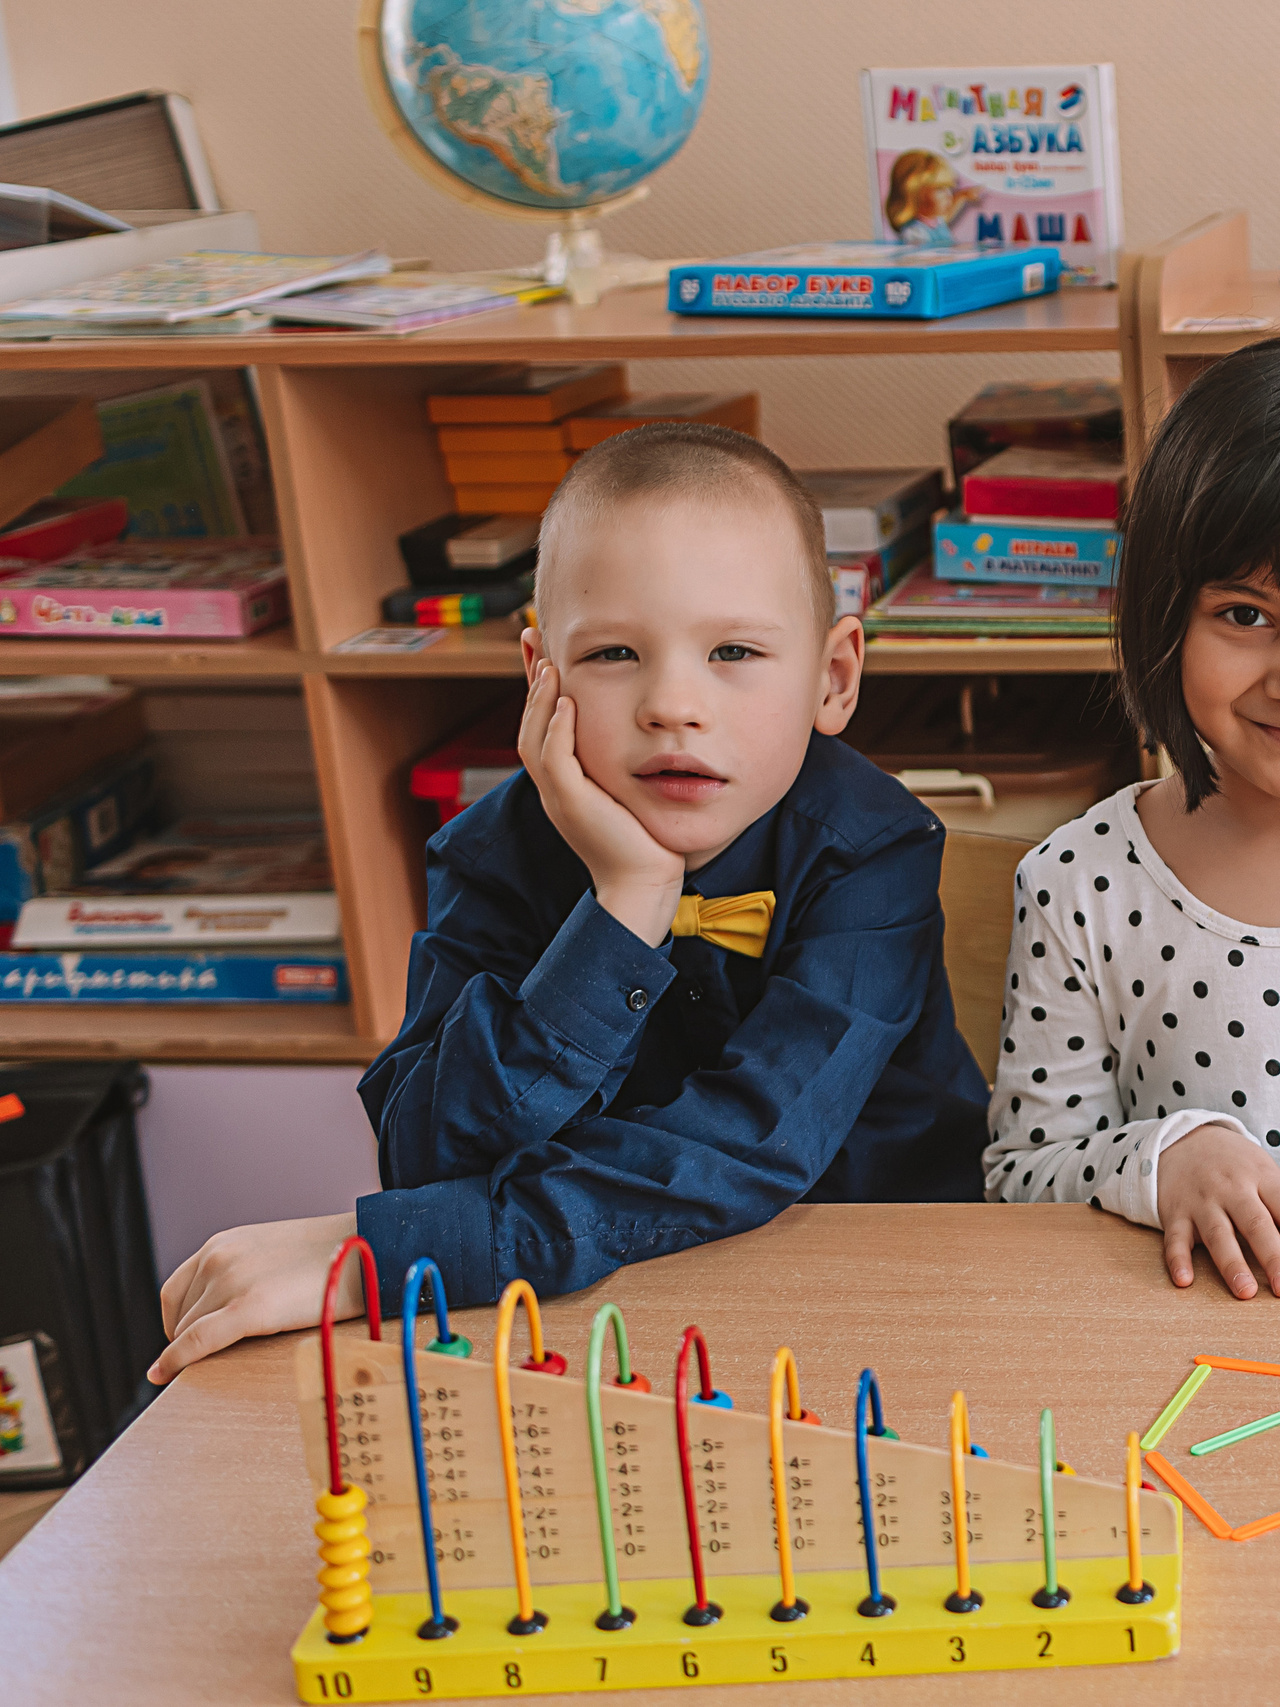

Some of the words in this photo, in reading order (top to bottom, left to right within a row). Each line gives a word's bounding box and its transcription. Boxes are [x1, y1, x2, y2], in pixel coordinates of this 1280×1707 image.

[972, 123, 1084, 153] АЗБУКА
[977, 213, 1092, 242] МАША
[712, 273, 799, 293] НАБОР
[806, 275, 875, 294] БУКВ
[316, 1671, 353, 1699] 10
[413, 1666, 433, 1694] 9
[503, 1661, 523, 1689] 8
[593, 1656, 609, 1683] 7
[680, 1651, 700, 1679] 6
[769, 1645, 789, 1673] 5
[860, 1641, 877, 1667] 4
[949, 1635, 967, 1663] 3
[1036, 1630, 1054, 1658] 2
[1125, 1626, 1138, 1653] 1
